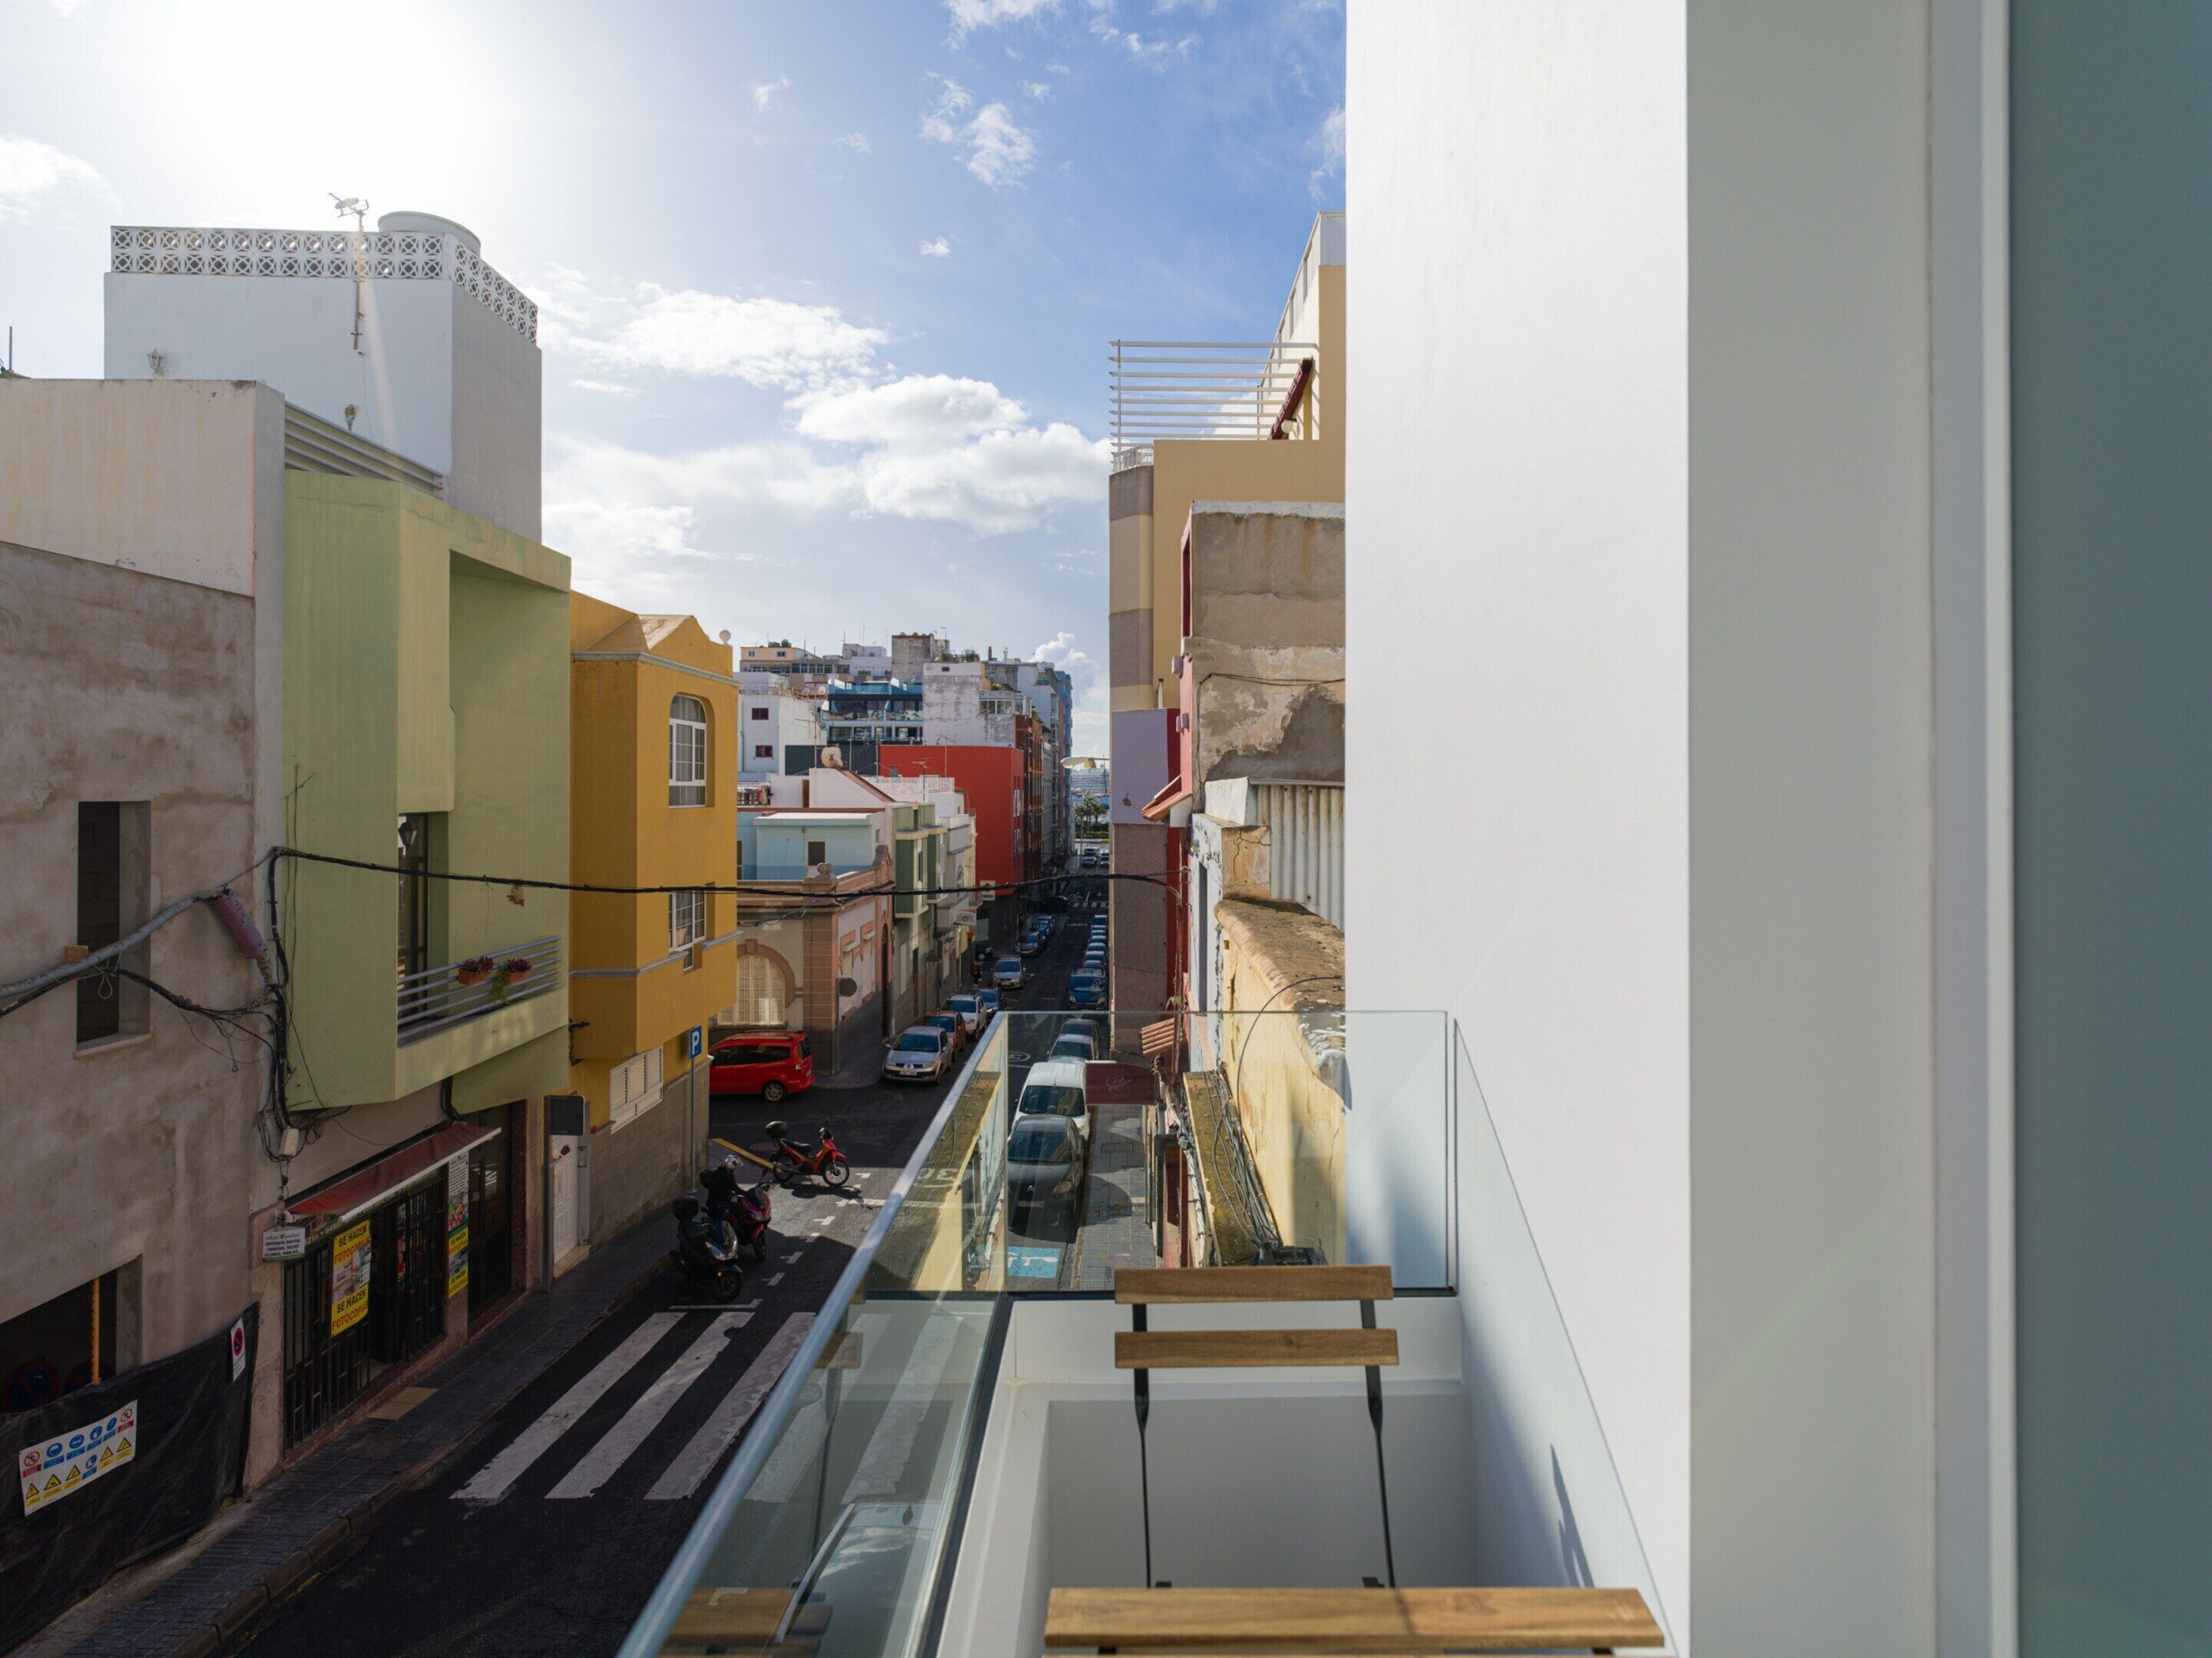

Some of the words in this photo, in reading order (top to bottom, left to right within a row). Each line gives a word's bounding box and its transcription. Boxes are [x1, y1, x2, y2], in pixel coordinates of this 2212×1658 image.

[692, 1031, 700, 1055] P
[338, 1235, 346, 1247] SE
[348, 1225, 366, 1242] HACEN
[337, 1302, 345, 1313] SE
[346, 1290, 366, 1307] HACEN
[333, 1300, 369, 1330] FOTOCOPIAS
